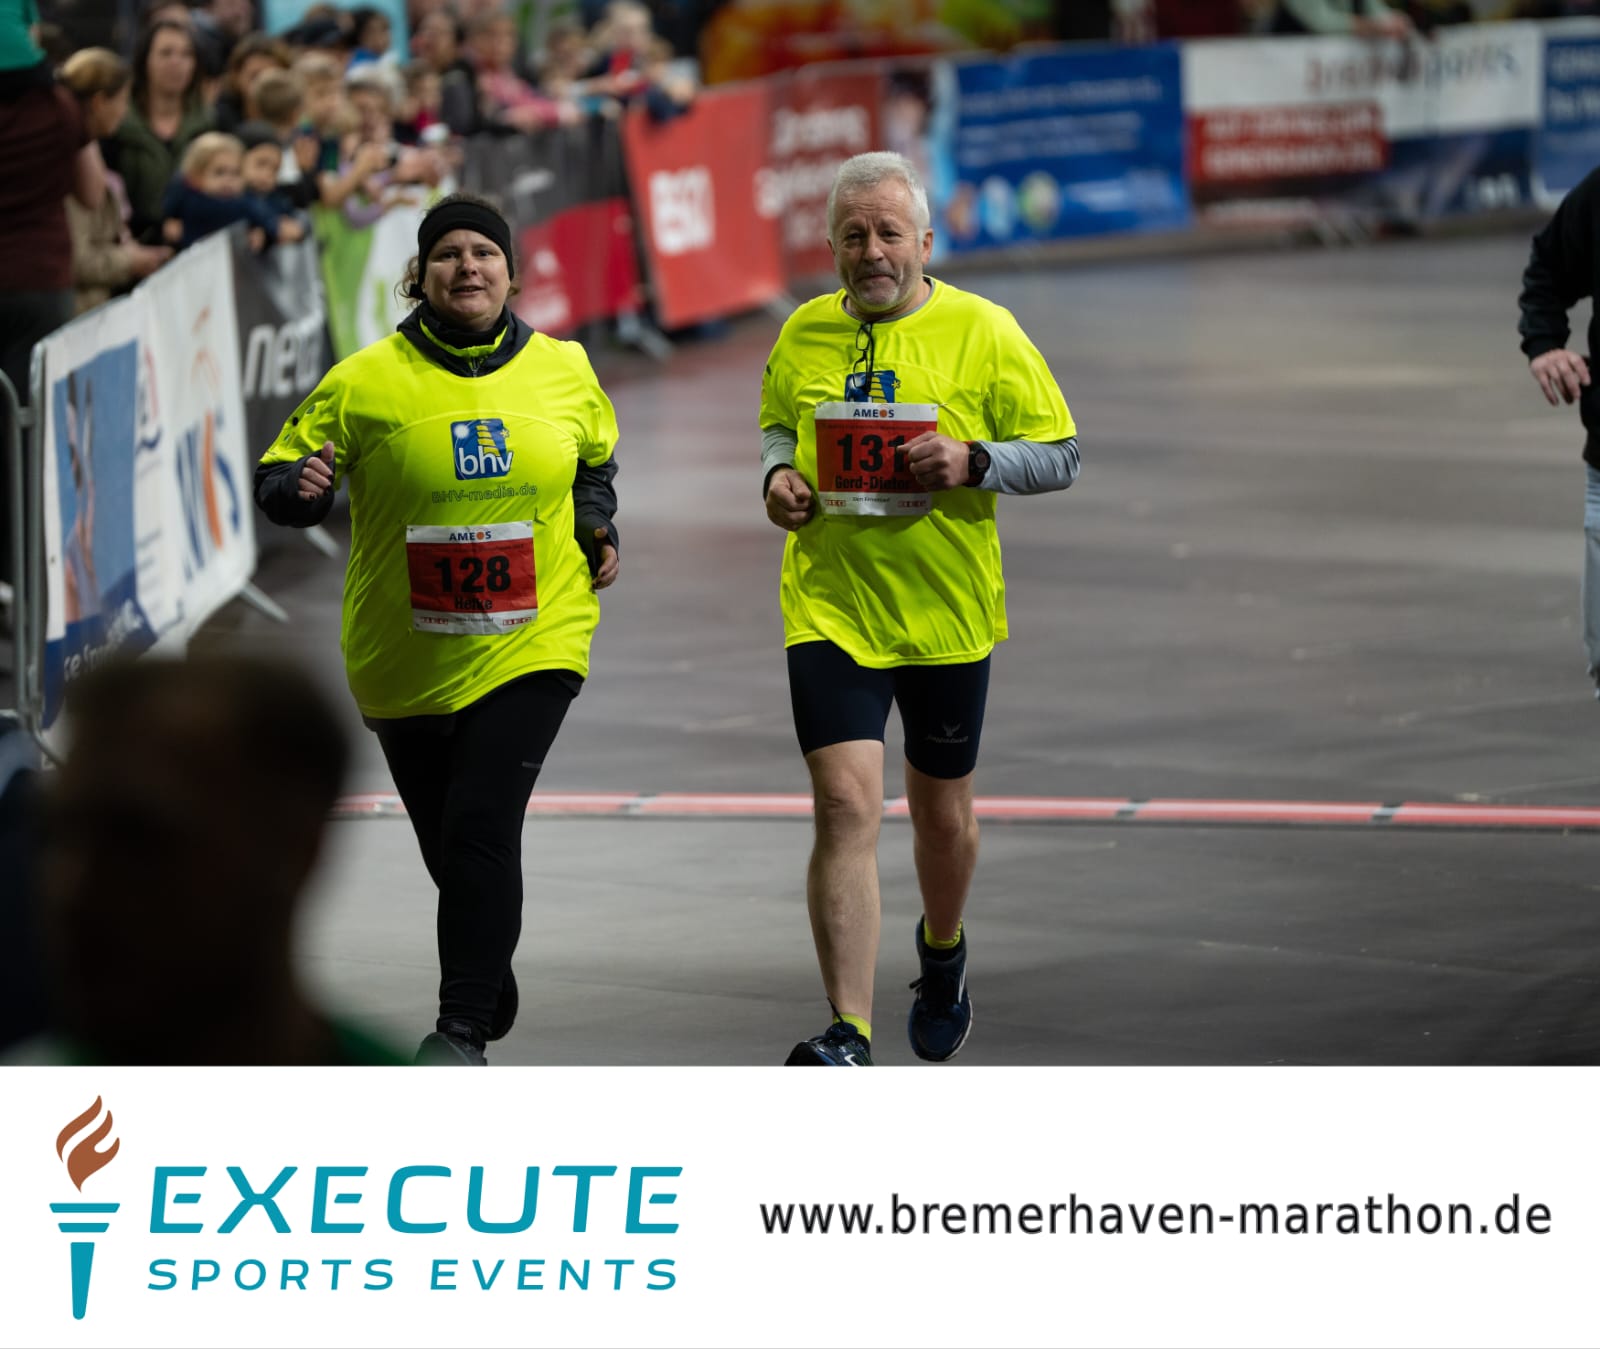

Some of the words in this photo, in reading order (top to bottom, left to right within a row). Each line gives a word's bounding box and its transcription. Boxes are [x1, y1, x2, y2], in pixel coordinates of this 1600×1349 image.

[853, 408, 895, 419] AMEOS
[458, 446, 514, 475] bhv
[837, 433, 906, 473] 131
[432, 482, 537, 503] BHV-media.de
[449, 530, 492, 542] AMEOS
[434, 555, 511, 594] 128
